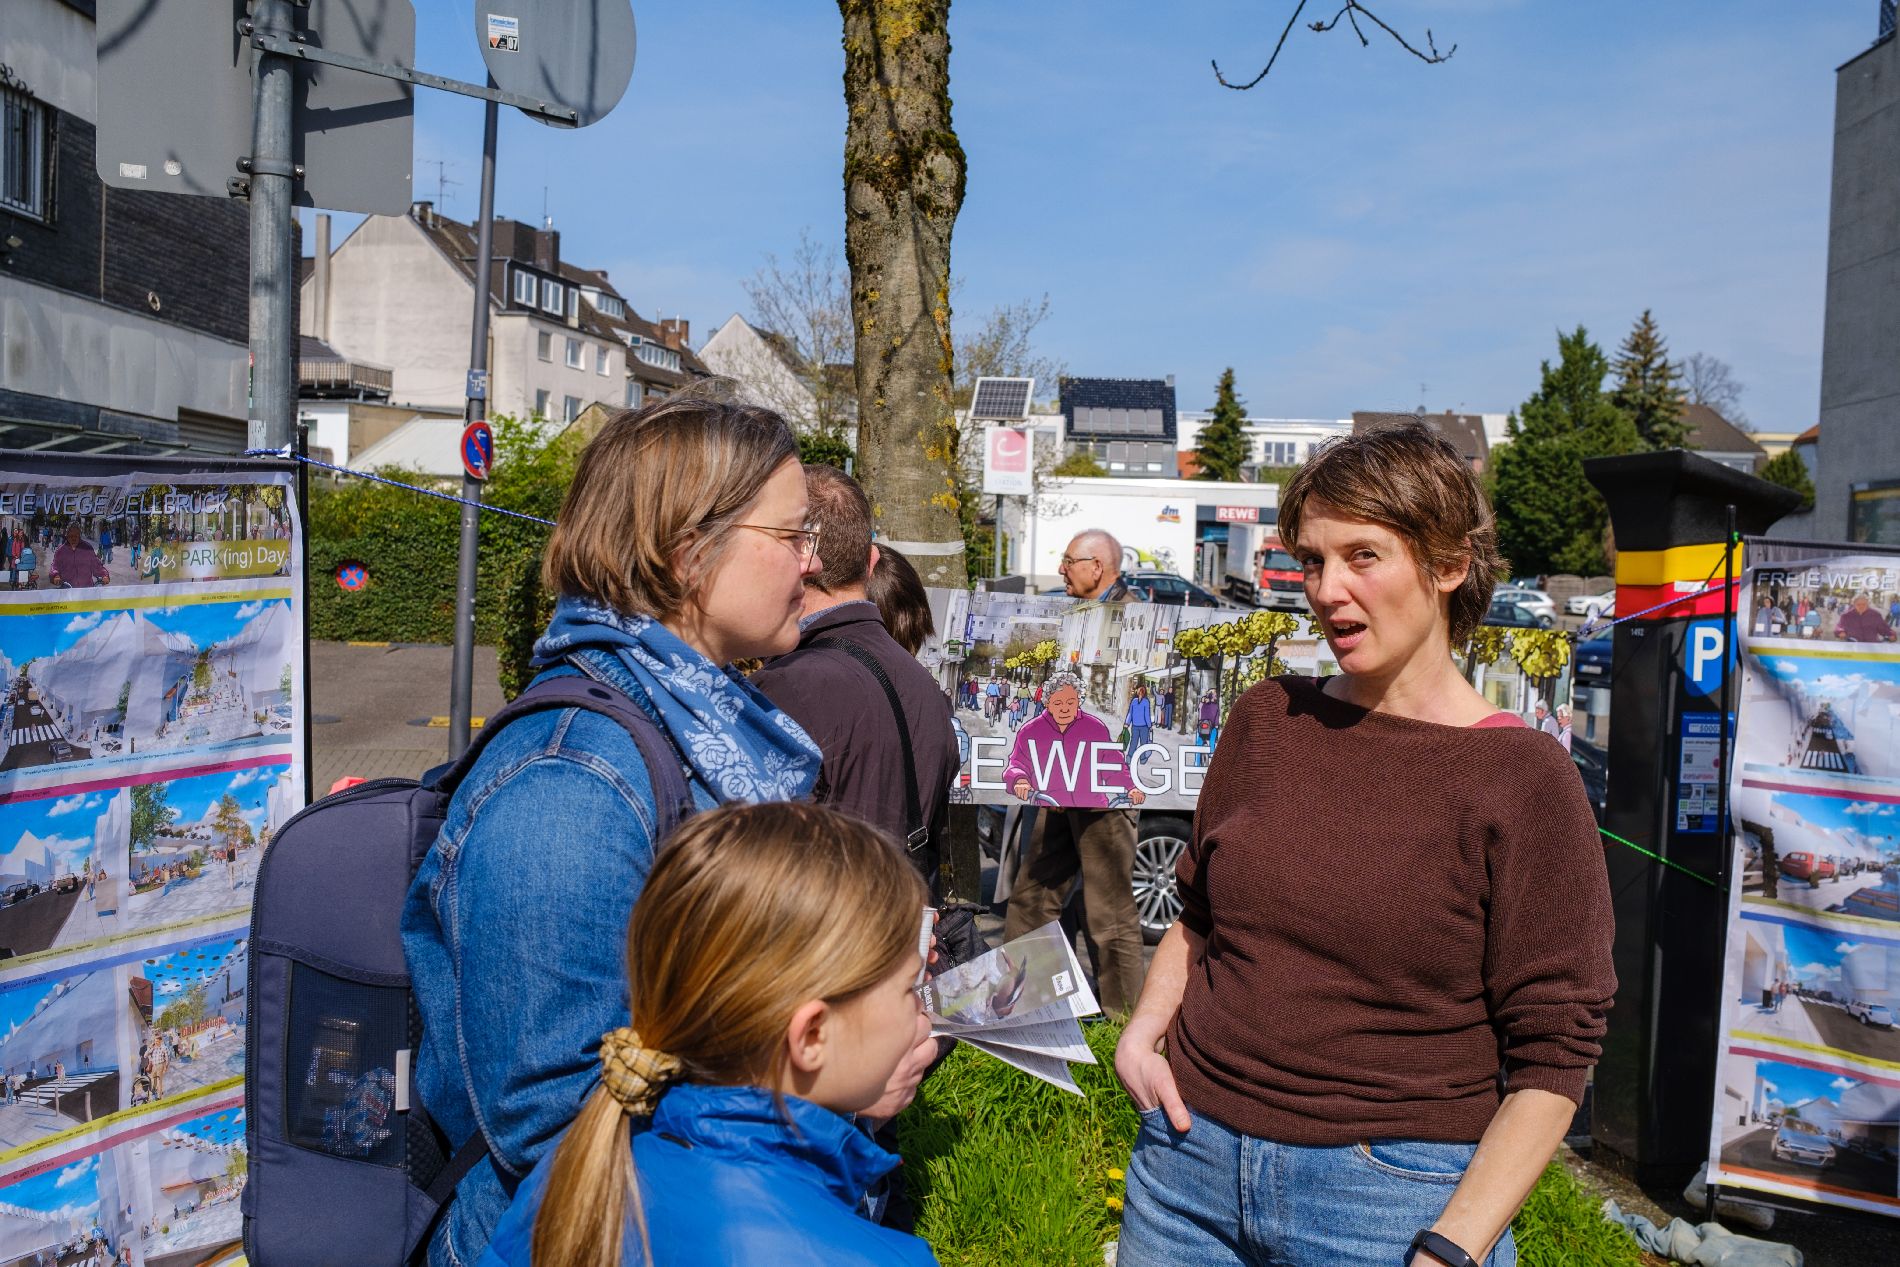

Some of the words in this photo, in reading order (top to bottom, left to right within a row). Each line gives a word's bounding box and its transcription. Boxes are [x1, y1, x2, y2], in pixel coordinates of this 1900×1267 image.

[508, 36, 519, 51] 07
[43, 493, 108, 515] WEGE
[110, 488, 229, 515] DELLBRÜCK
[1161, 504, 1180, 516] dm
[1218, 507, 1257, 520] REWE
[143, 551, 177, 574] goes
[180, 547, 253, 570] PARK(ing)
[257, 546, 286, 567] Day
[1756, 571, 1821, 589] FREIE
[1827, 572, 1898, 591] WEGE
[1693, 626, 1724, 682] P
[1027, 737, 1211, 796] WEGE
